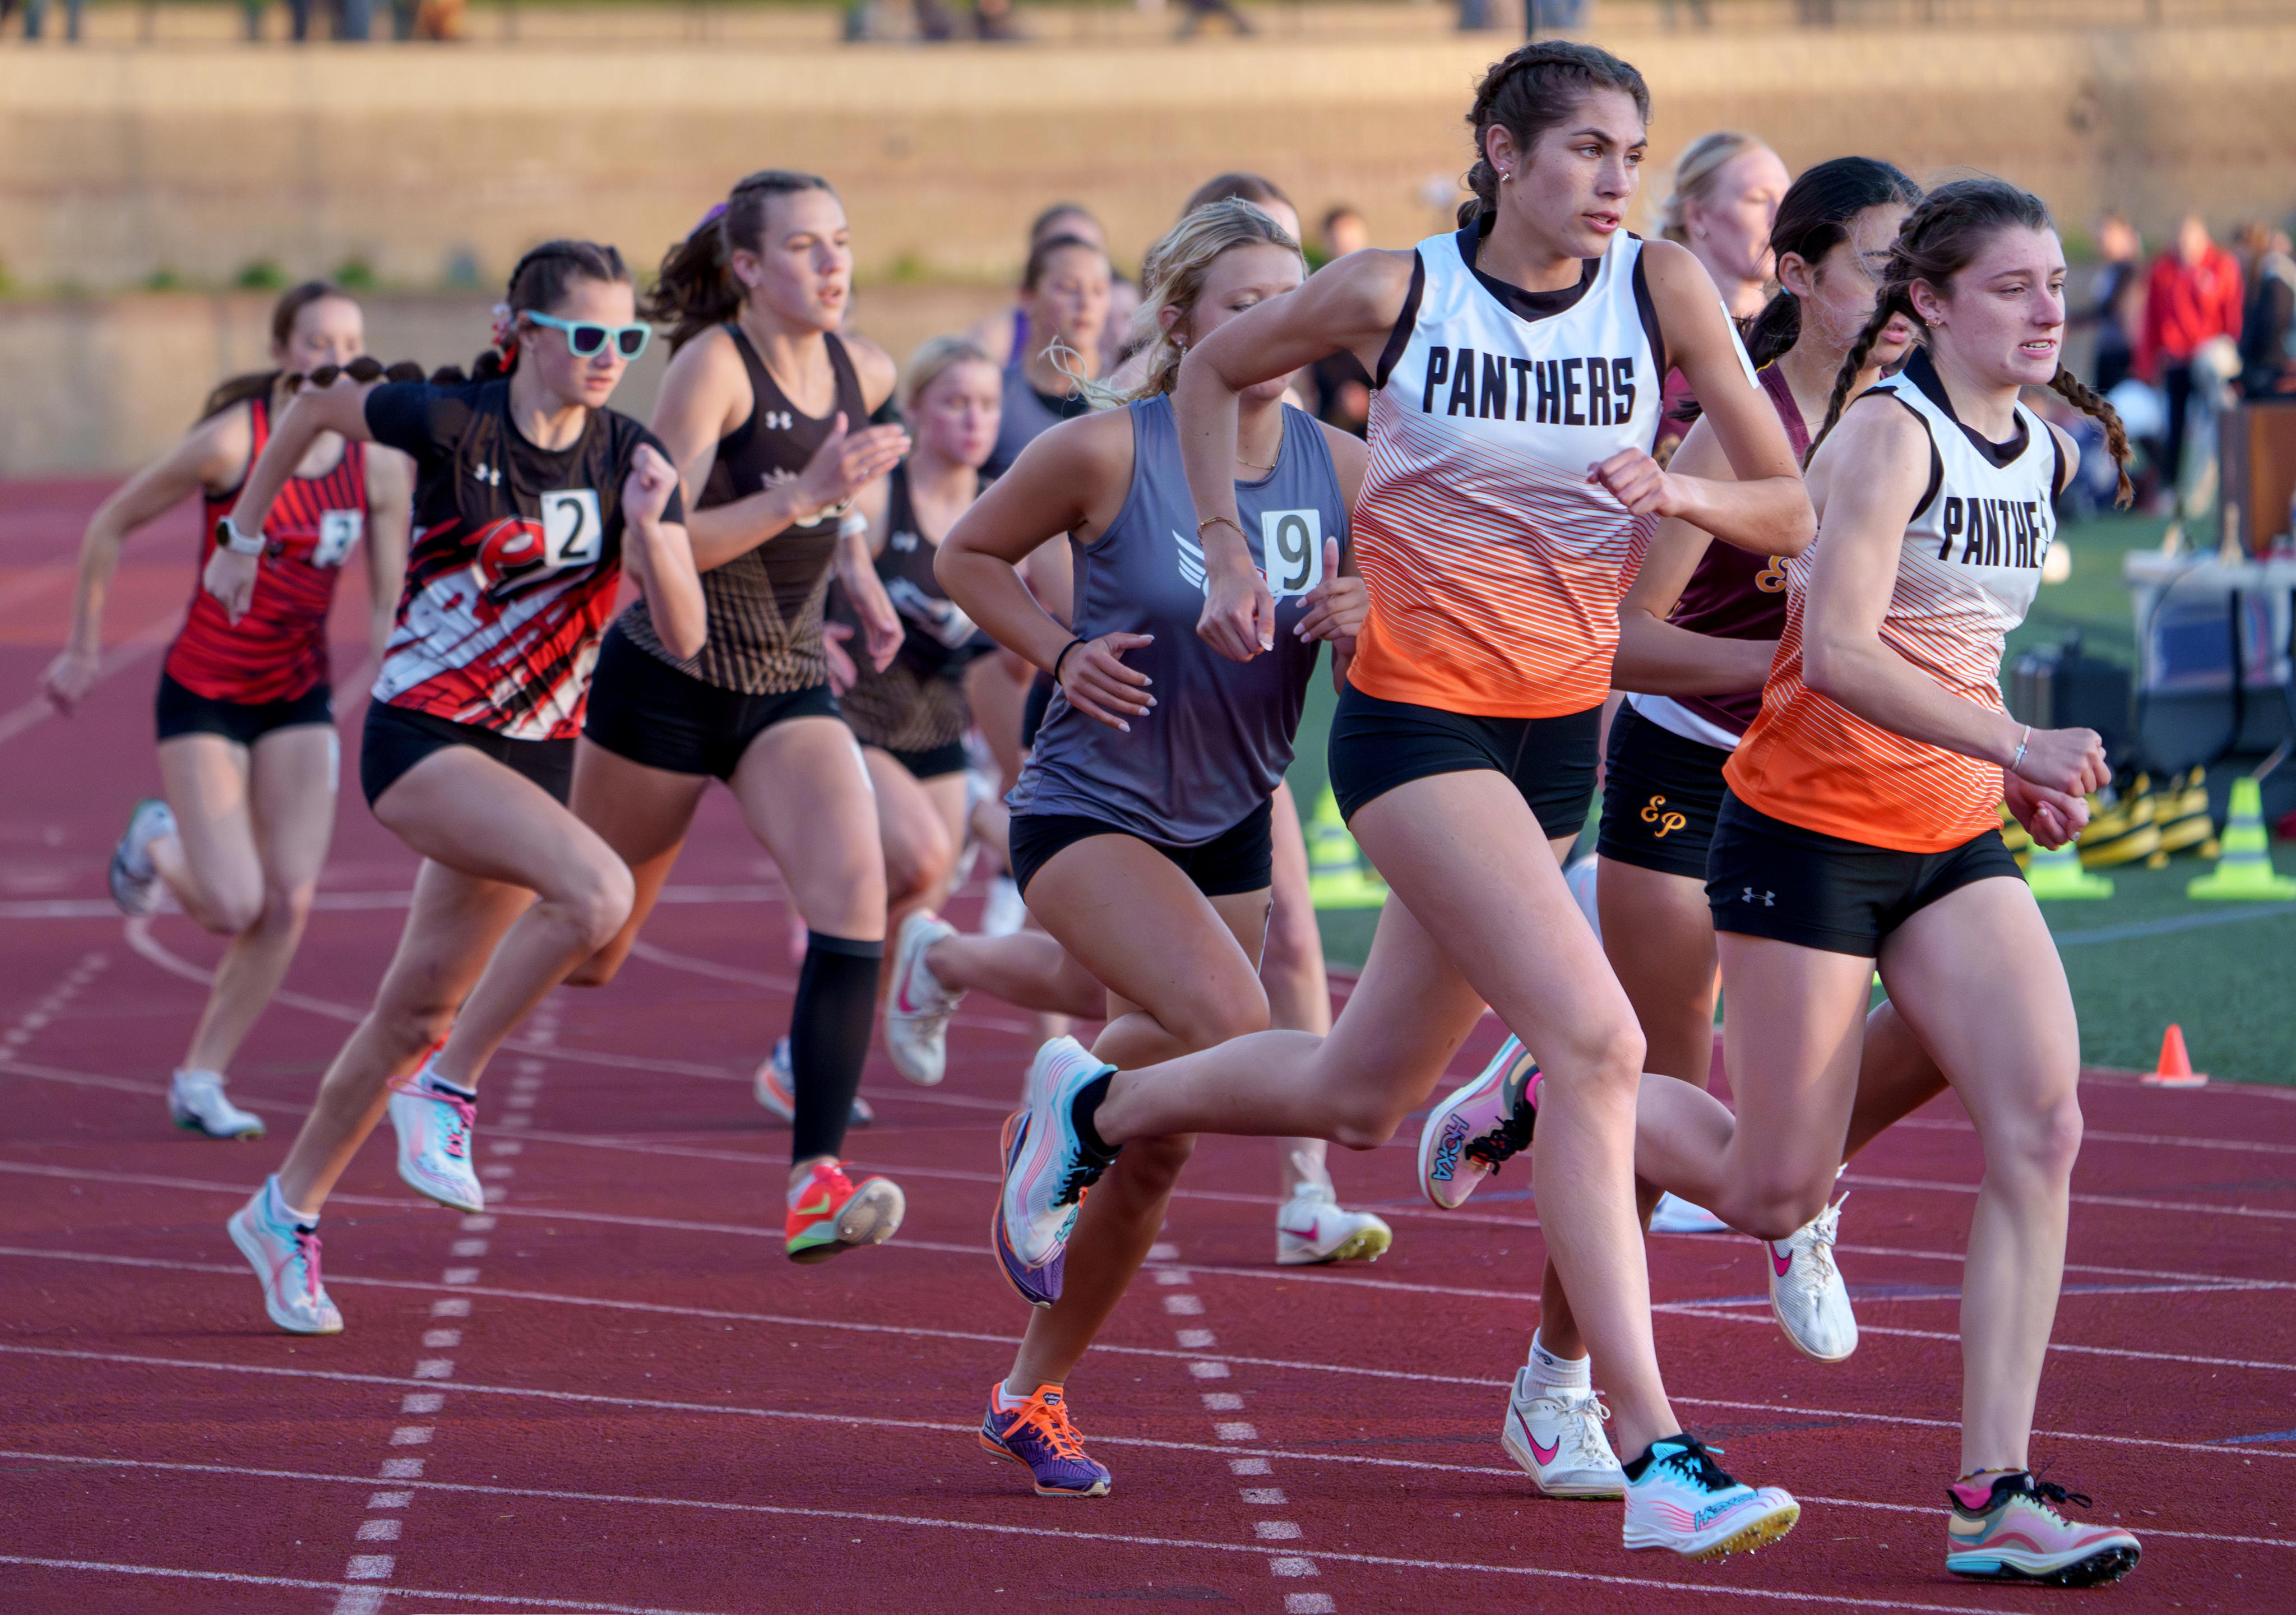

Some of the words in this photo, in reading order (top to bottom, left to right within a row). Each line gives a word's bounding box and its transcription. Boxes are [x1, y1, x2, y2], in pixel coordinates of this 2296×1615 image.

[1423, 346, 1636, 427] PANTHERS
[557, 497, 588, 558] 2
[1277, 514, 1312, 590] 9
[1938, 496, 2049, 568] PANTHE
[1640, 794, 1686, 837] EP
[1432, 1113, 1470, 1181] HOKA
